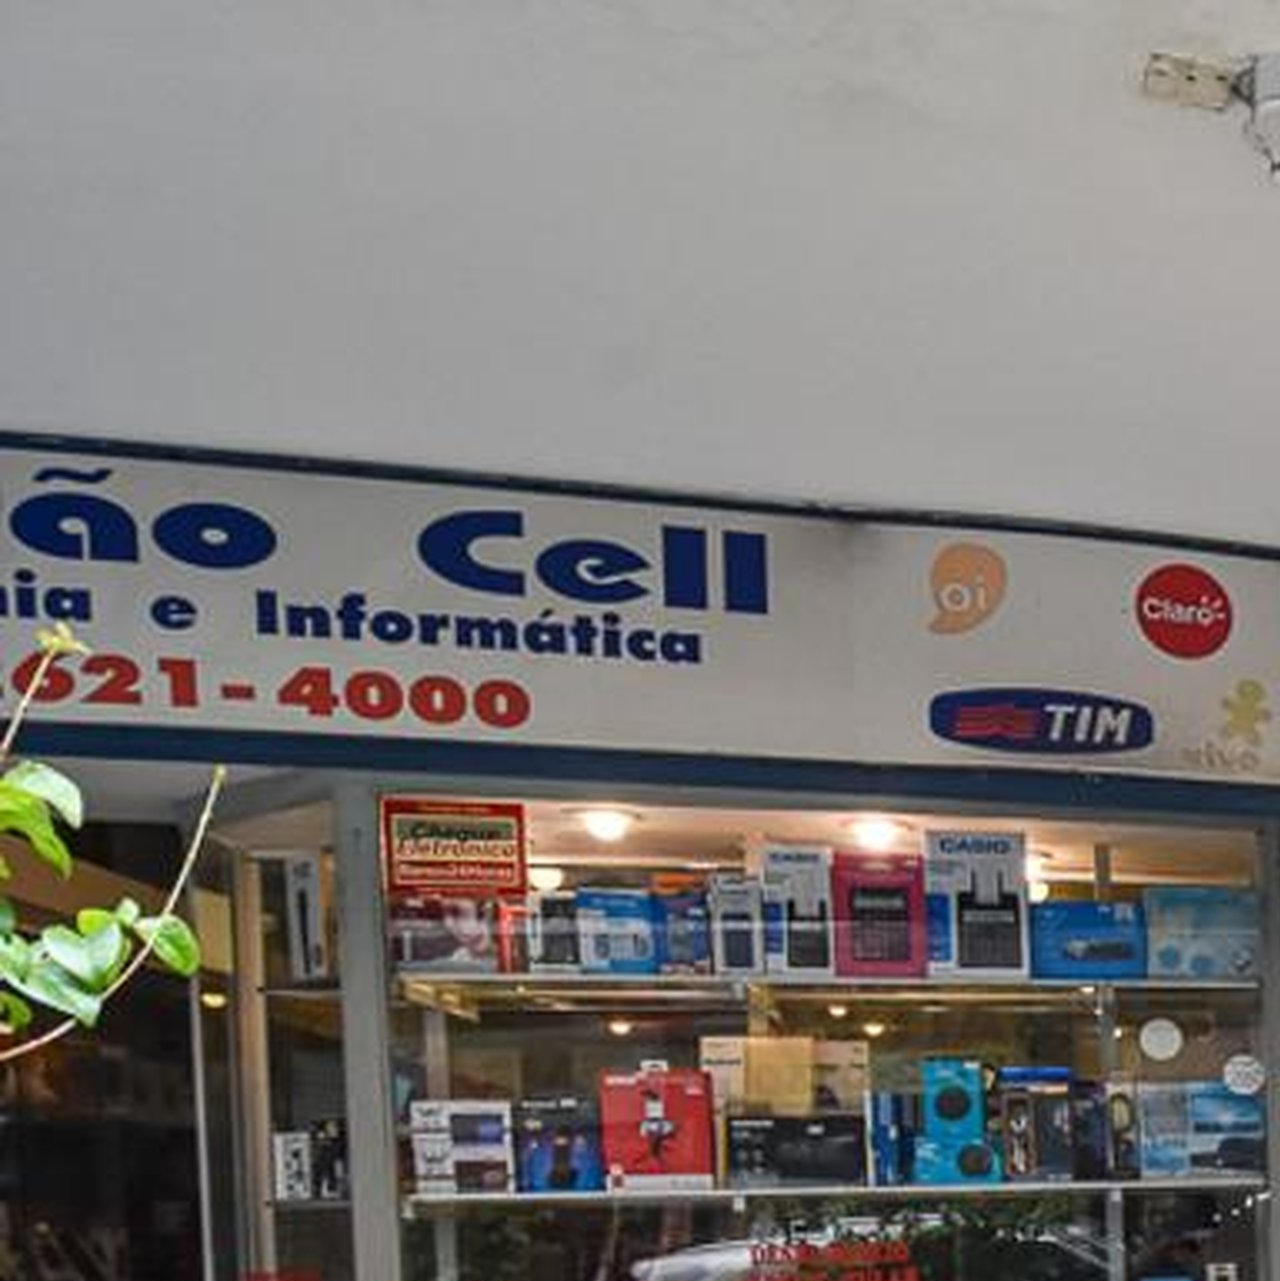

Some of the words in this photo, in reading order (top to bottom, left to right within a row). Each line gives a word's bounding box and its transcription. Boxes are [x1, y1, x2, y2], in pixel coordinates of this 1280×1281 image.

[418, 510, 769, 615] Cell
[0, 567, 91, 622] ia
[150, 595, 197, 631] e
[256, 589, 702, 664] Informática
[1143, 595, 1226, 628] Claro
[0, 650, 531, 729] 621-4000
[1044, 704, 1133, 745] TIM
[939, 836, 1012, 855] CASIO
